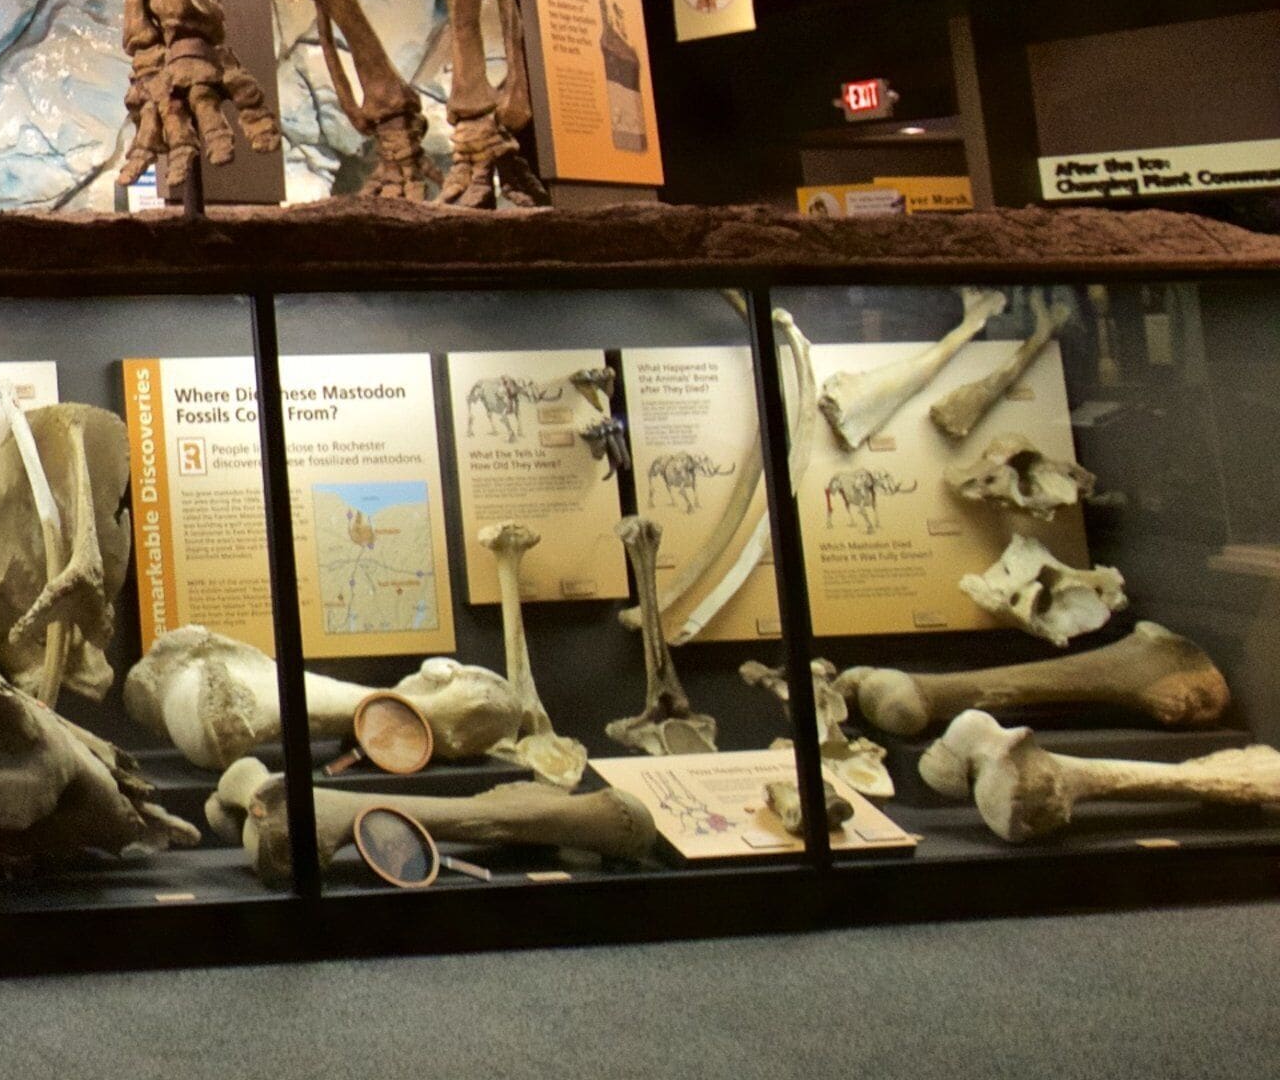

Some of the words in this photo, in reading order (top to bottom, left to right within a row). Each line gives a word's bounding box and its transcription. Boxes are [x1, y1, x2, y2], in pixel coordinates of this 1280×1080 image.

[848, 83, 878, 110] EXIT
[1055, 160, 1099, 177] After
[1103, 157, 1134, 173] the
[1056, 177, 1139, 198] Changing
[1143, 171, 1192, 189] Plant
[663, 363, 707, 373] Happened
[693, 373, 719, 382] Bones
[175, 387, 230, 404] Where
[323, 384, 406, 401] Mastodon
[662, 385, 684, 395] They
[685, 384, 710, 393] Died?
[176, 407, 231, 424] Fossils
[235, 407, 257, 423] Co
[288, 405, 338, 421] From?
[134, 368, 158, 503] Discoveries
[212, 443, 249, 456] People
[287, 443, 314, 453] close
[318, 442, 329, 452] to
[332, 440, 386, 453] Rochester
[470, 450, 494, 460] What
[515, 448, 533, 459] Tells
[535, 448, 546, 458] Us
[308, 455, 359, 468] fossilized
[470, 460, 491, 470] How
[492, 460, 510, 470] Old
[511, 460, 531, 471] They
[534, 459, 562, 469] Were?
[819, 541, 846, 551] Which
[143, 510, 167, 638] emarkable
